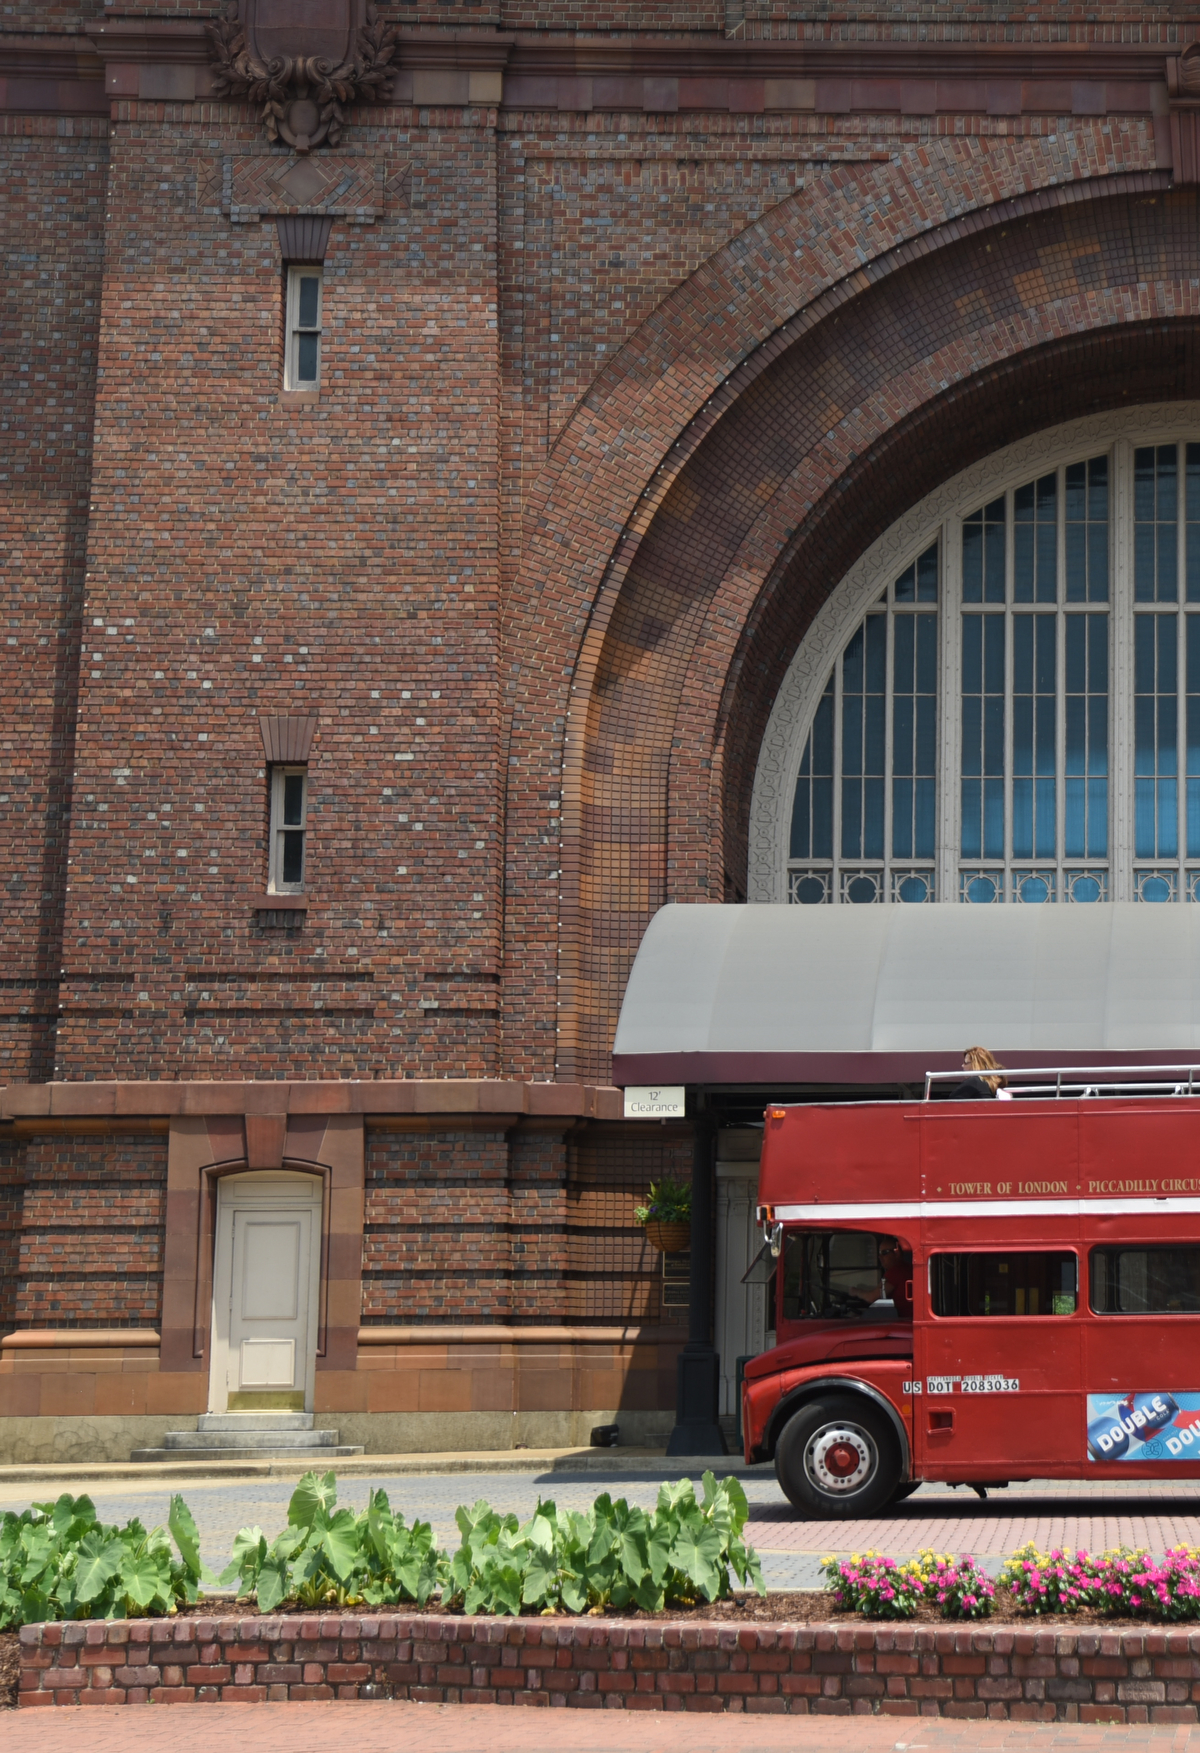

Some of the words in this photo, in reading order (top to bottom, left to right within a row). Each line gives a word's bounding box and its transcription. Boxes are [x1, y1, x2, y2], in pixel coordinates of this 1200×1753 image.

[648, 1091, 662, 1101] 12'
[631, 1102, 678, 1112] Clearance
[948, 1182, 992, 1195] TOWER
[996, 1182, 1013, 1195] OF
[1018, 1181, 1068, 1194] LONDON
[1088, 1179, 1159, 1193] PICCADILLY
[903, 1382, 921, 1393] US
[928, 1381, 952, 1392] DOT
[962, 1379, 1018, 1392] 2083036
[1155, 1409, 1170, 1421] COLA
[1097, 1395, 1167, 1452] DOUBLE
